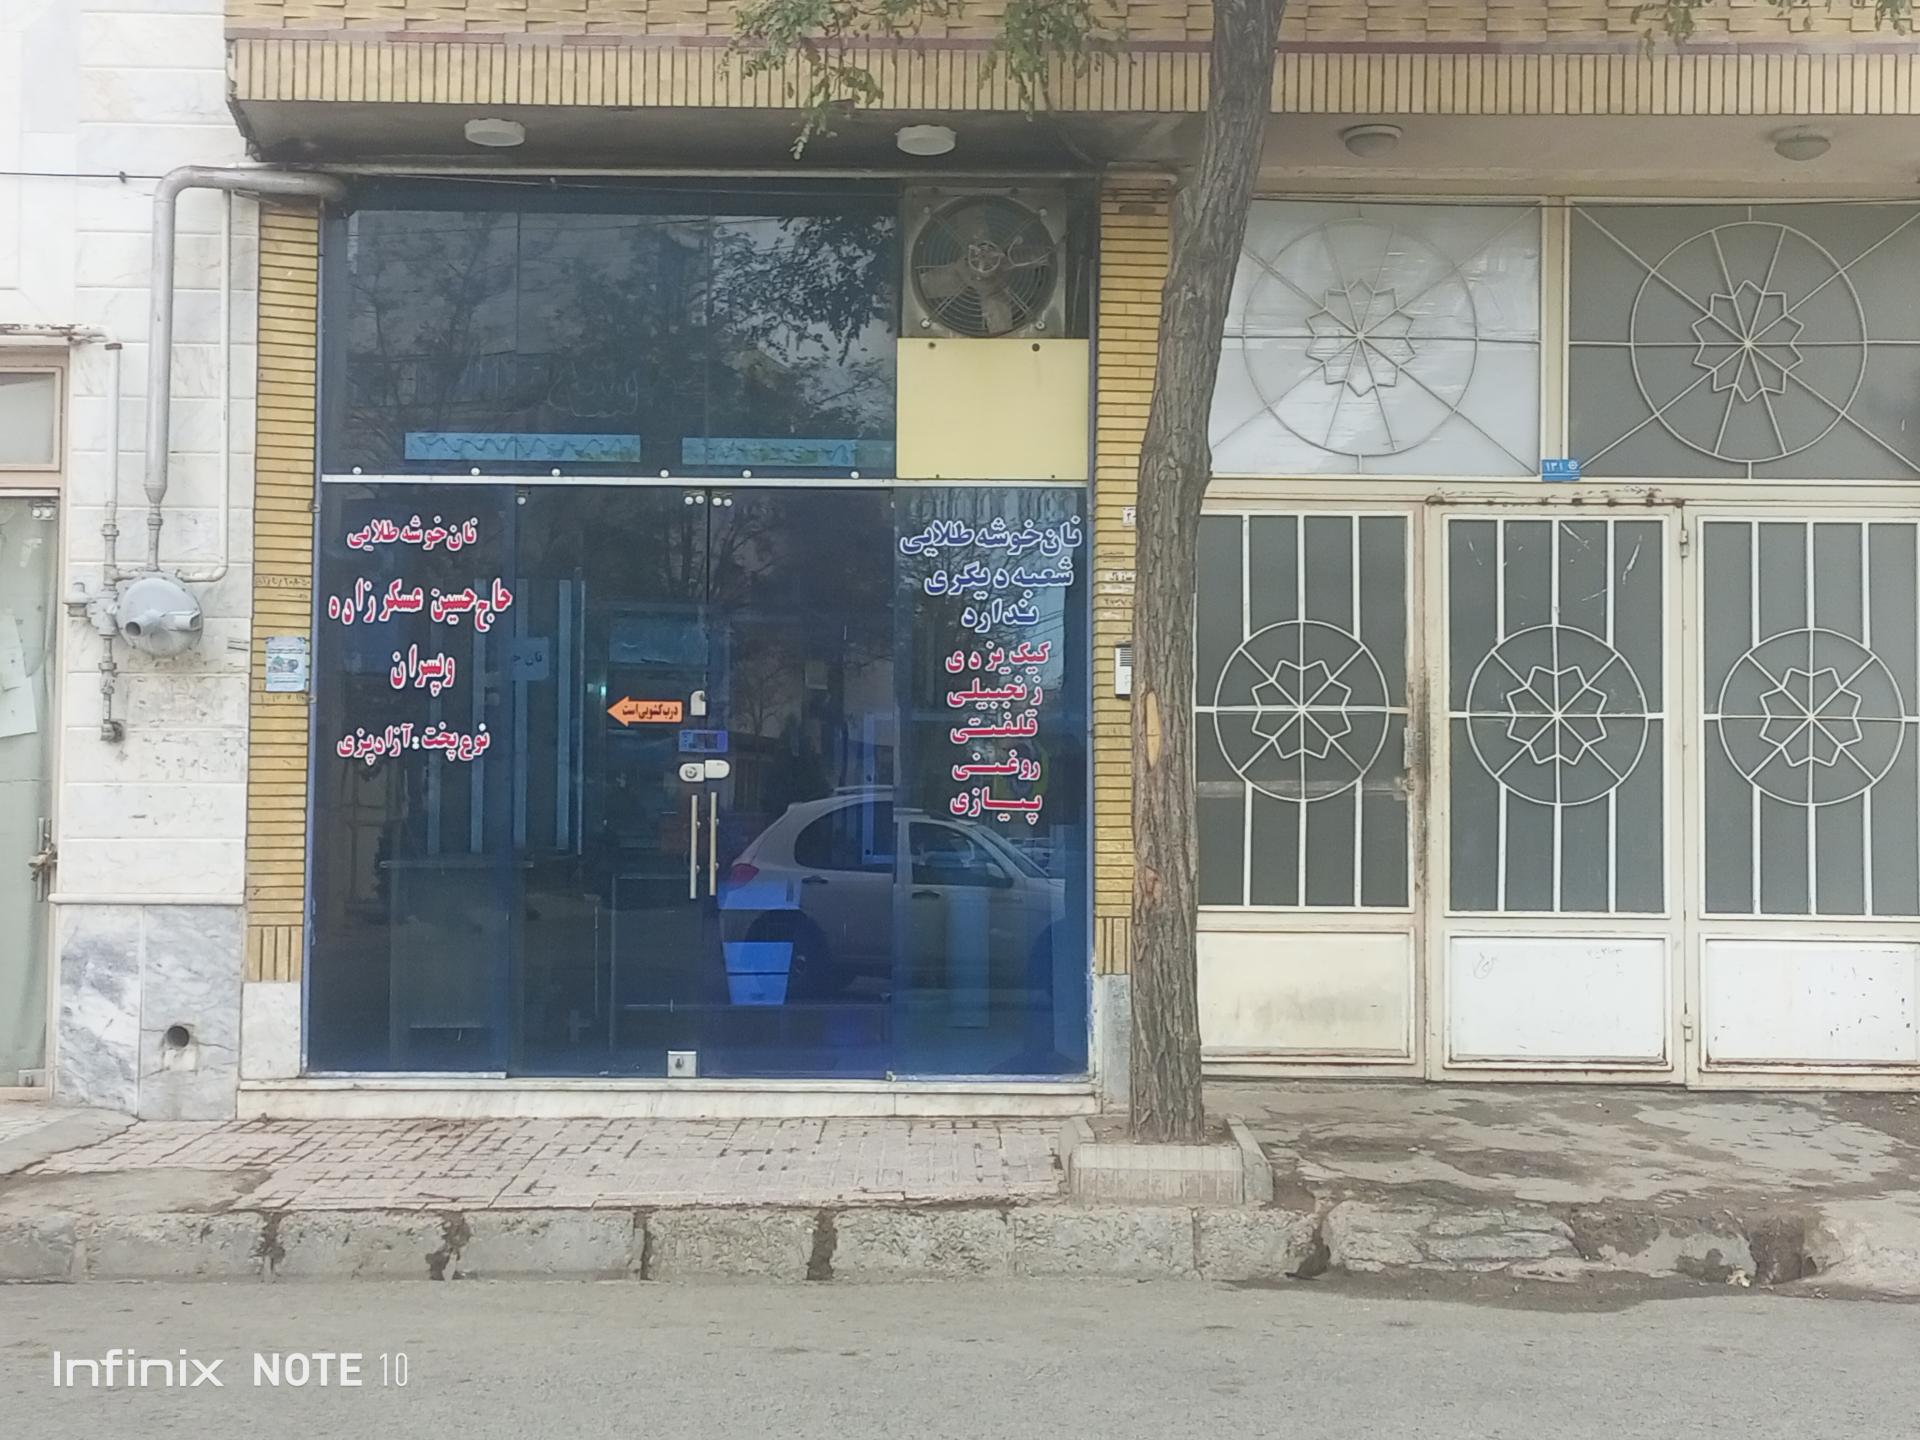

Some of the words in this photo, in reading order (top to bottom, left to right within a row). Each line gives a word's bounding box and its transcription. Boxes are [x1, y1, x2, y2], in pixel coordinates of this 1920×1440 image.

[347, 519, 400, 552] طلایی
[400, 515, 447, 551] خوشه
[446, 517, 478, 552] نان
[899, 519, 976, 558] طلایی
[975, 517, 1041, 555] خوشه
[1040, 515, 1082, 555] نان
[1011, 557, 1074, 587] شعبه
[430, 586, 477, 624] حسین
[474, 577, 514, 632] حاج
[961, 590, 1039, 633] نداره
[945, 640, 1004, 675] یزدی
[1008, 641, 1052, 674] کیک
[946, 675, 1043, 711] زنجبیلی
[457, 723, 490, 761] نوع
[950, 709, 1038, 743] قلفتی
[951, 749, 1042, 782] روغنی
[949, 786, 1043, 826] پیازی
